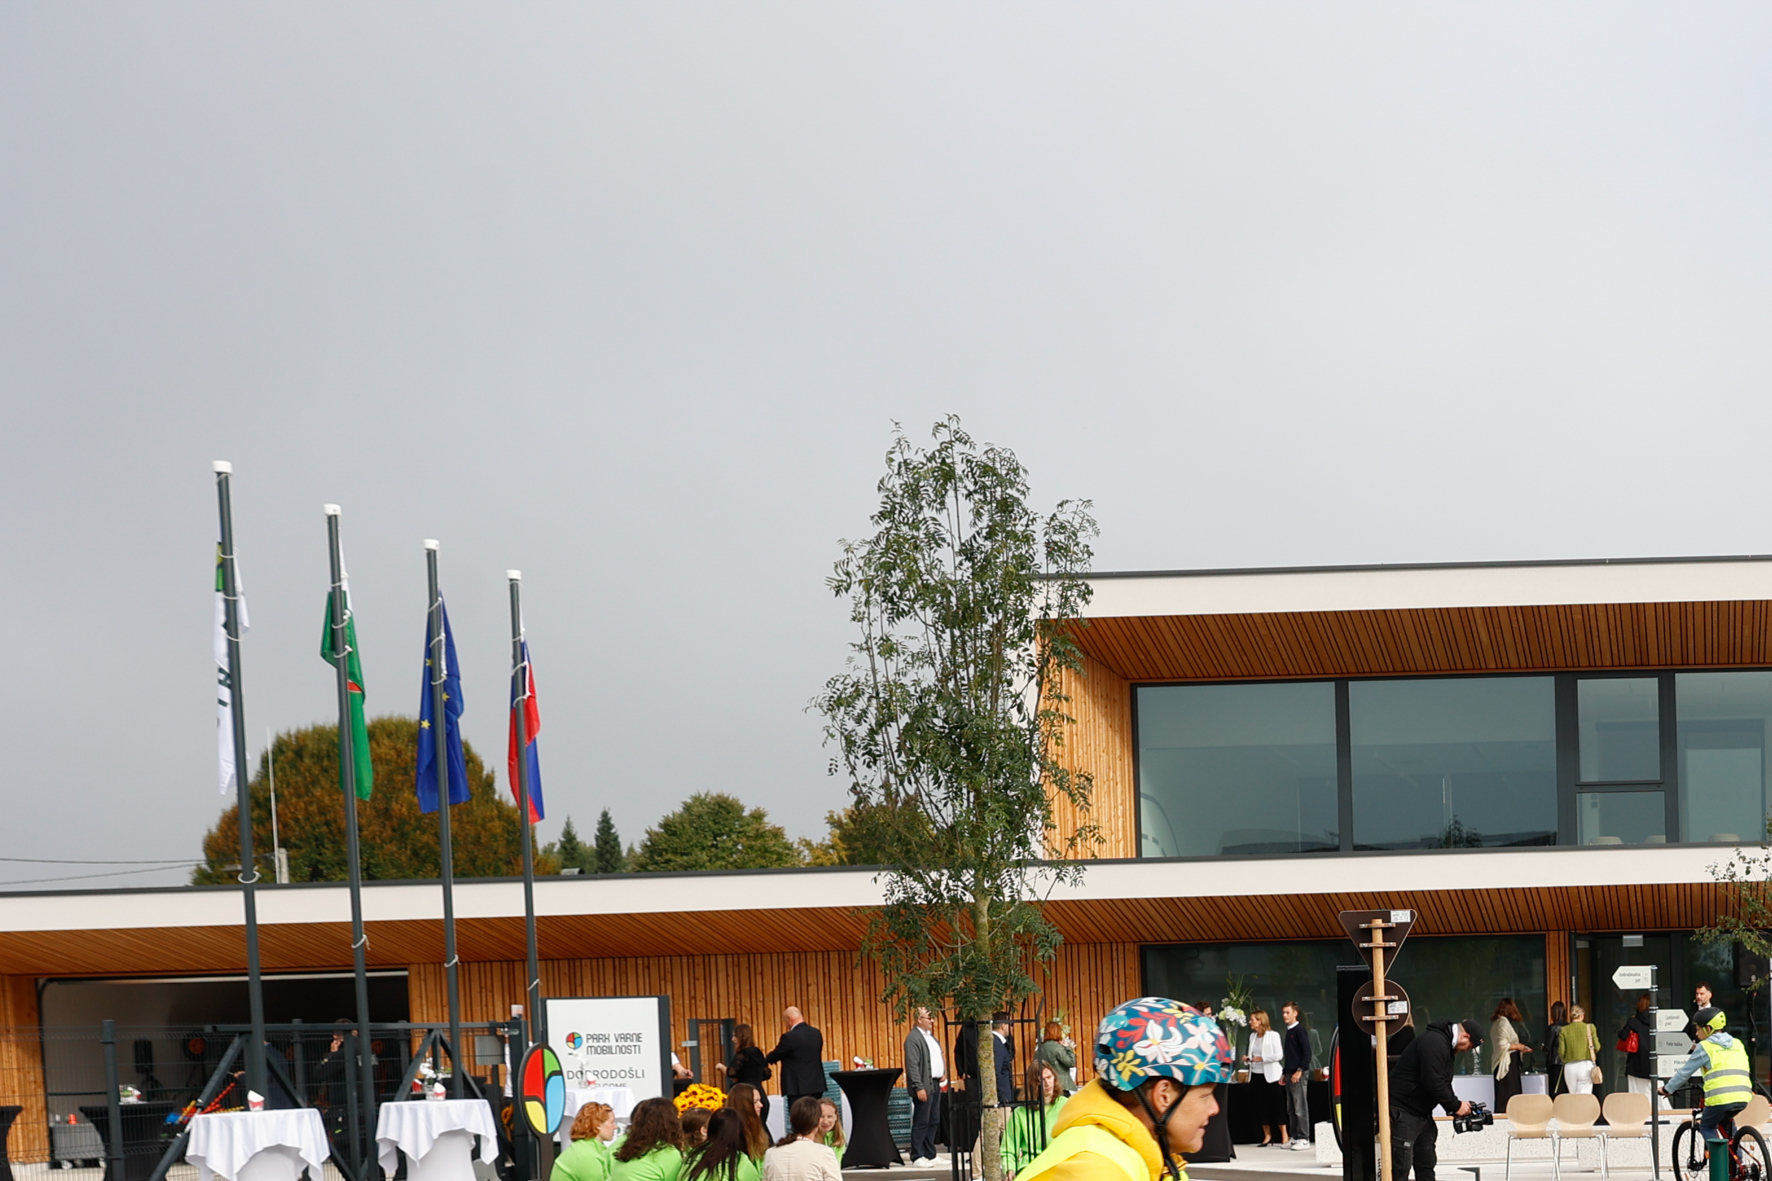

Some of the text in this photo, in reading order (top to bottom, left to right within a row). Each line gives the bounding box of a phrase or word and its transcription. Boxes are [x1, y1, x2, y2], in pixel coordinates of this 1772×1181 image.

[586, 1033, 643, 1043] PARK VARNE
[586, 1045, 641, 1055] MOBILNOSTI
